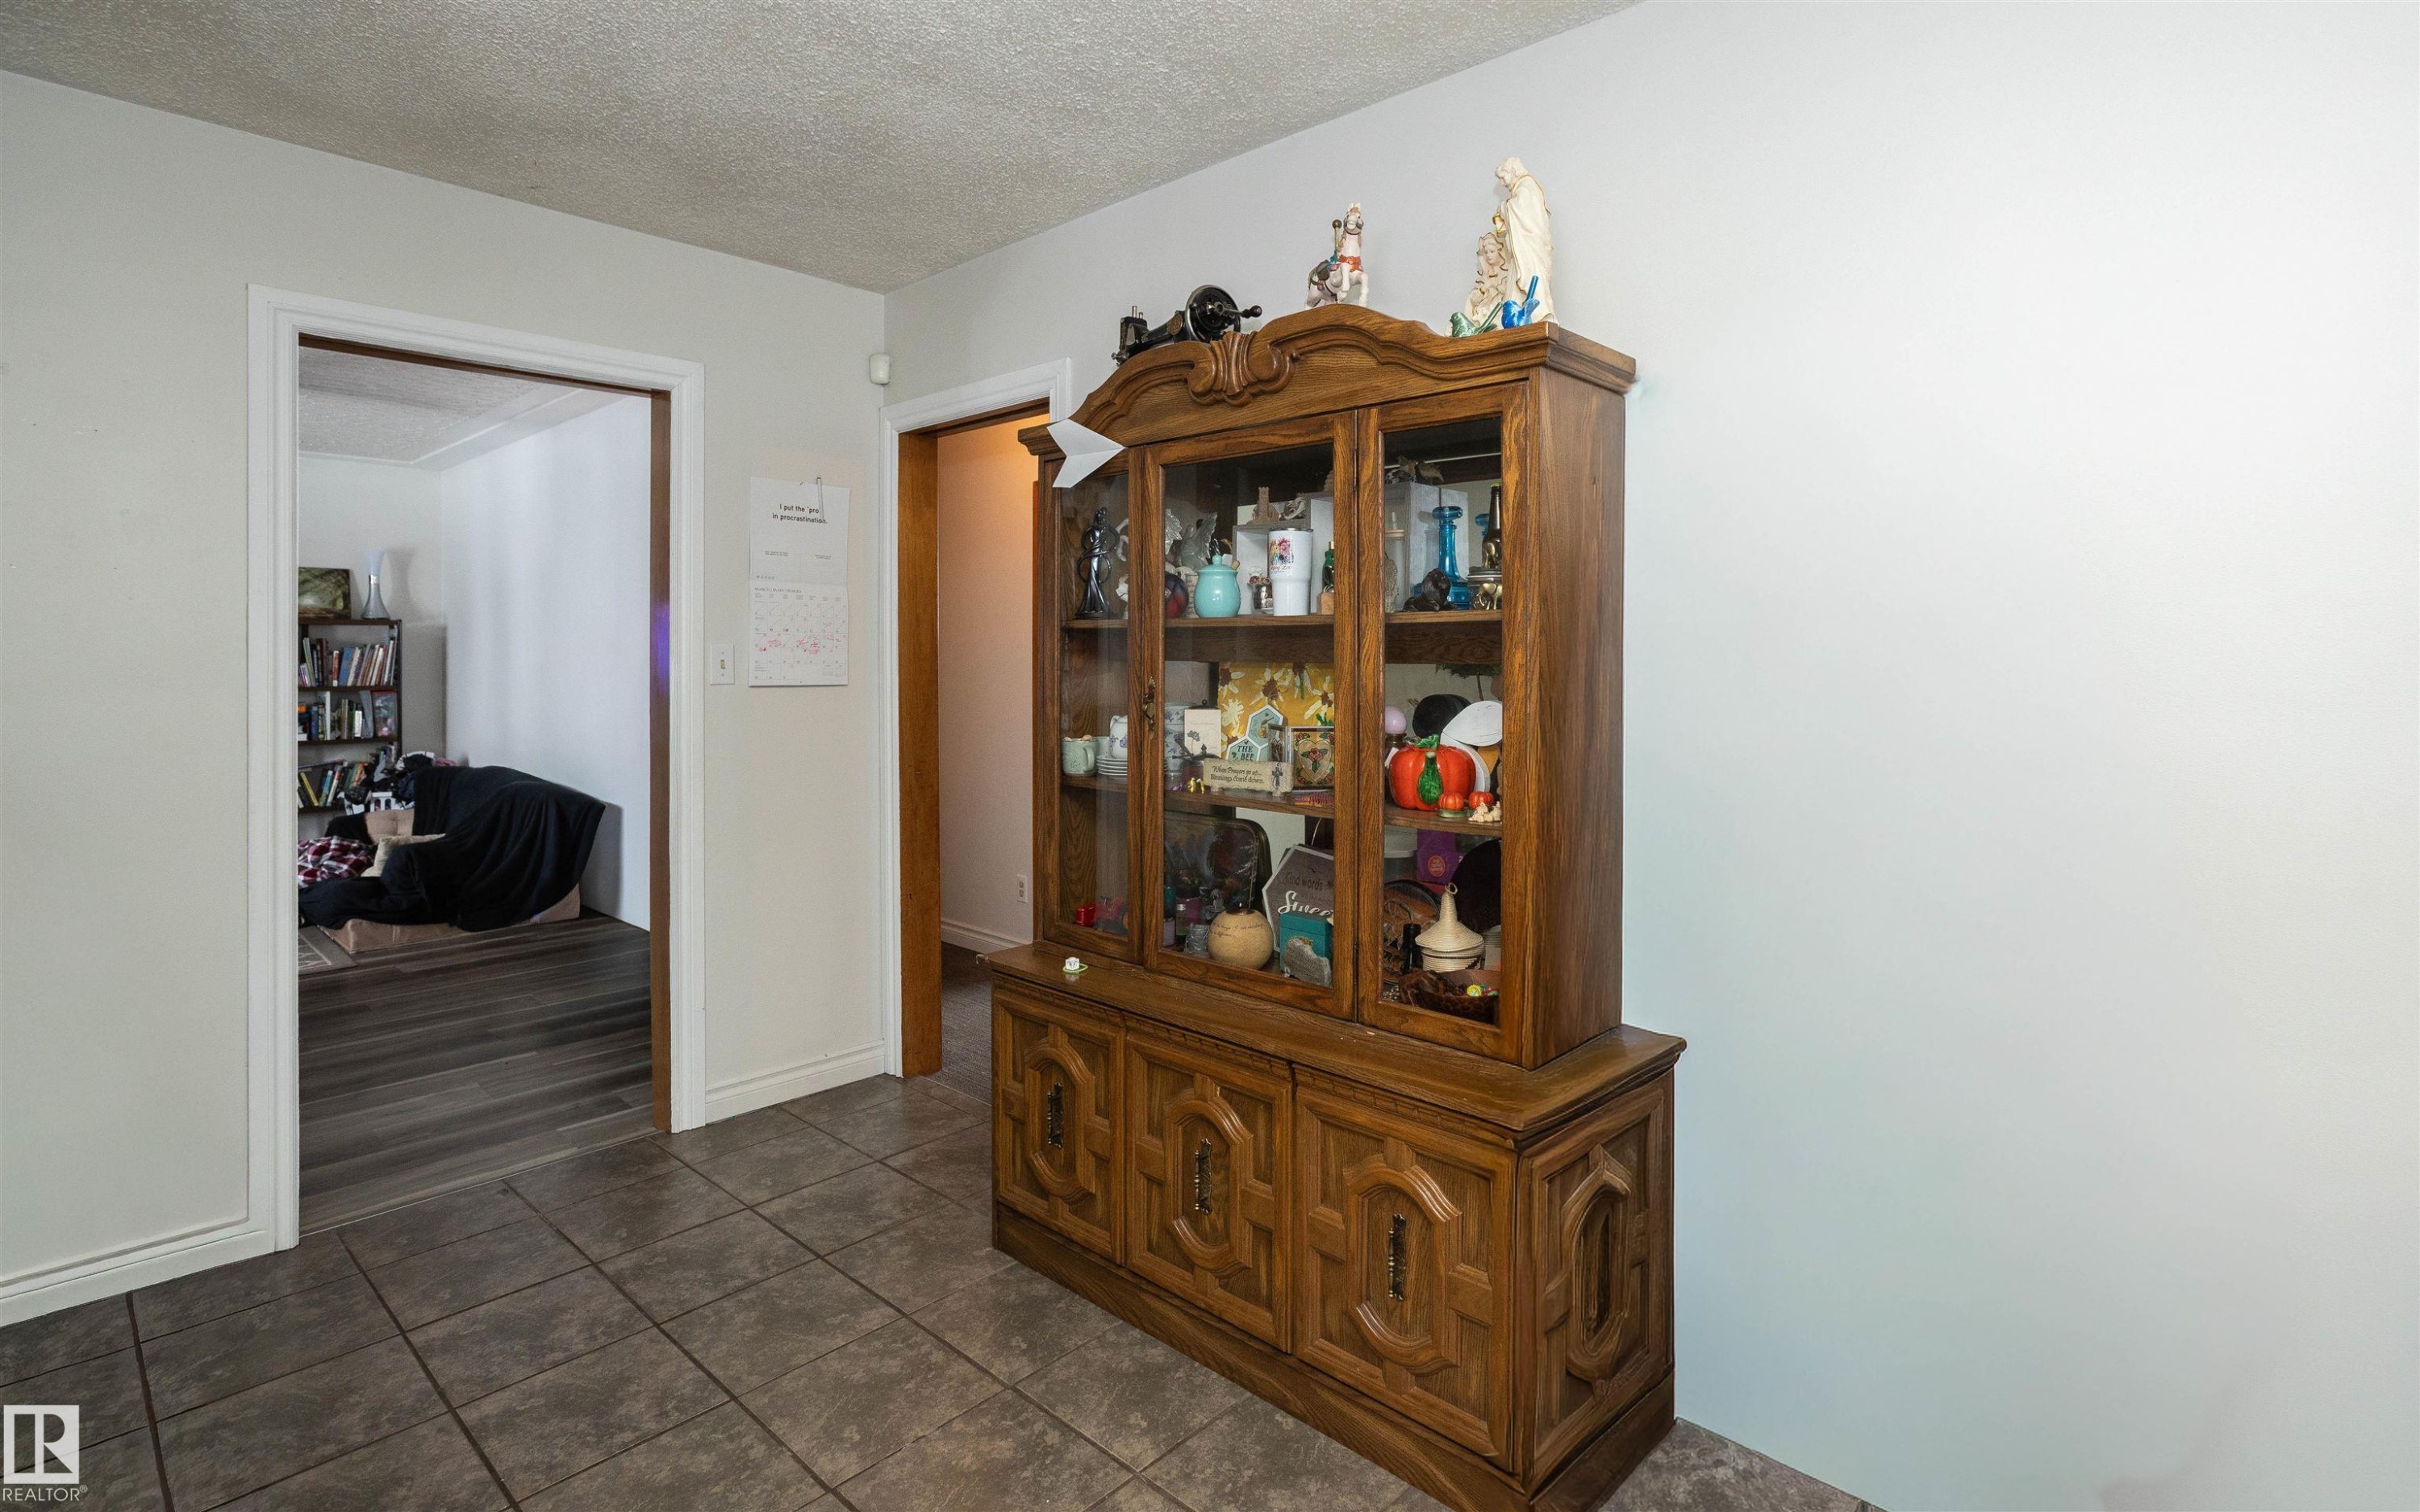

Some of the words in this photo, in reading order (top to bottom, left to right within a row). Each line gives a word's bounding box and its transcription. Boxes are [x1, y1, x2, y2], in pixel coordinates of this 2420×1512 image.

[1212, 765, 1227, 773] When
[1302, 877, 1323, 891] words
[1278, 890, 1333, 917] Swee
